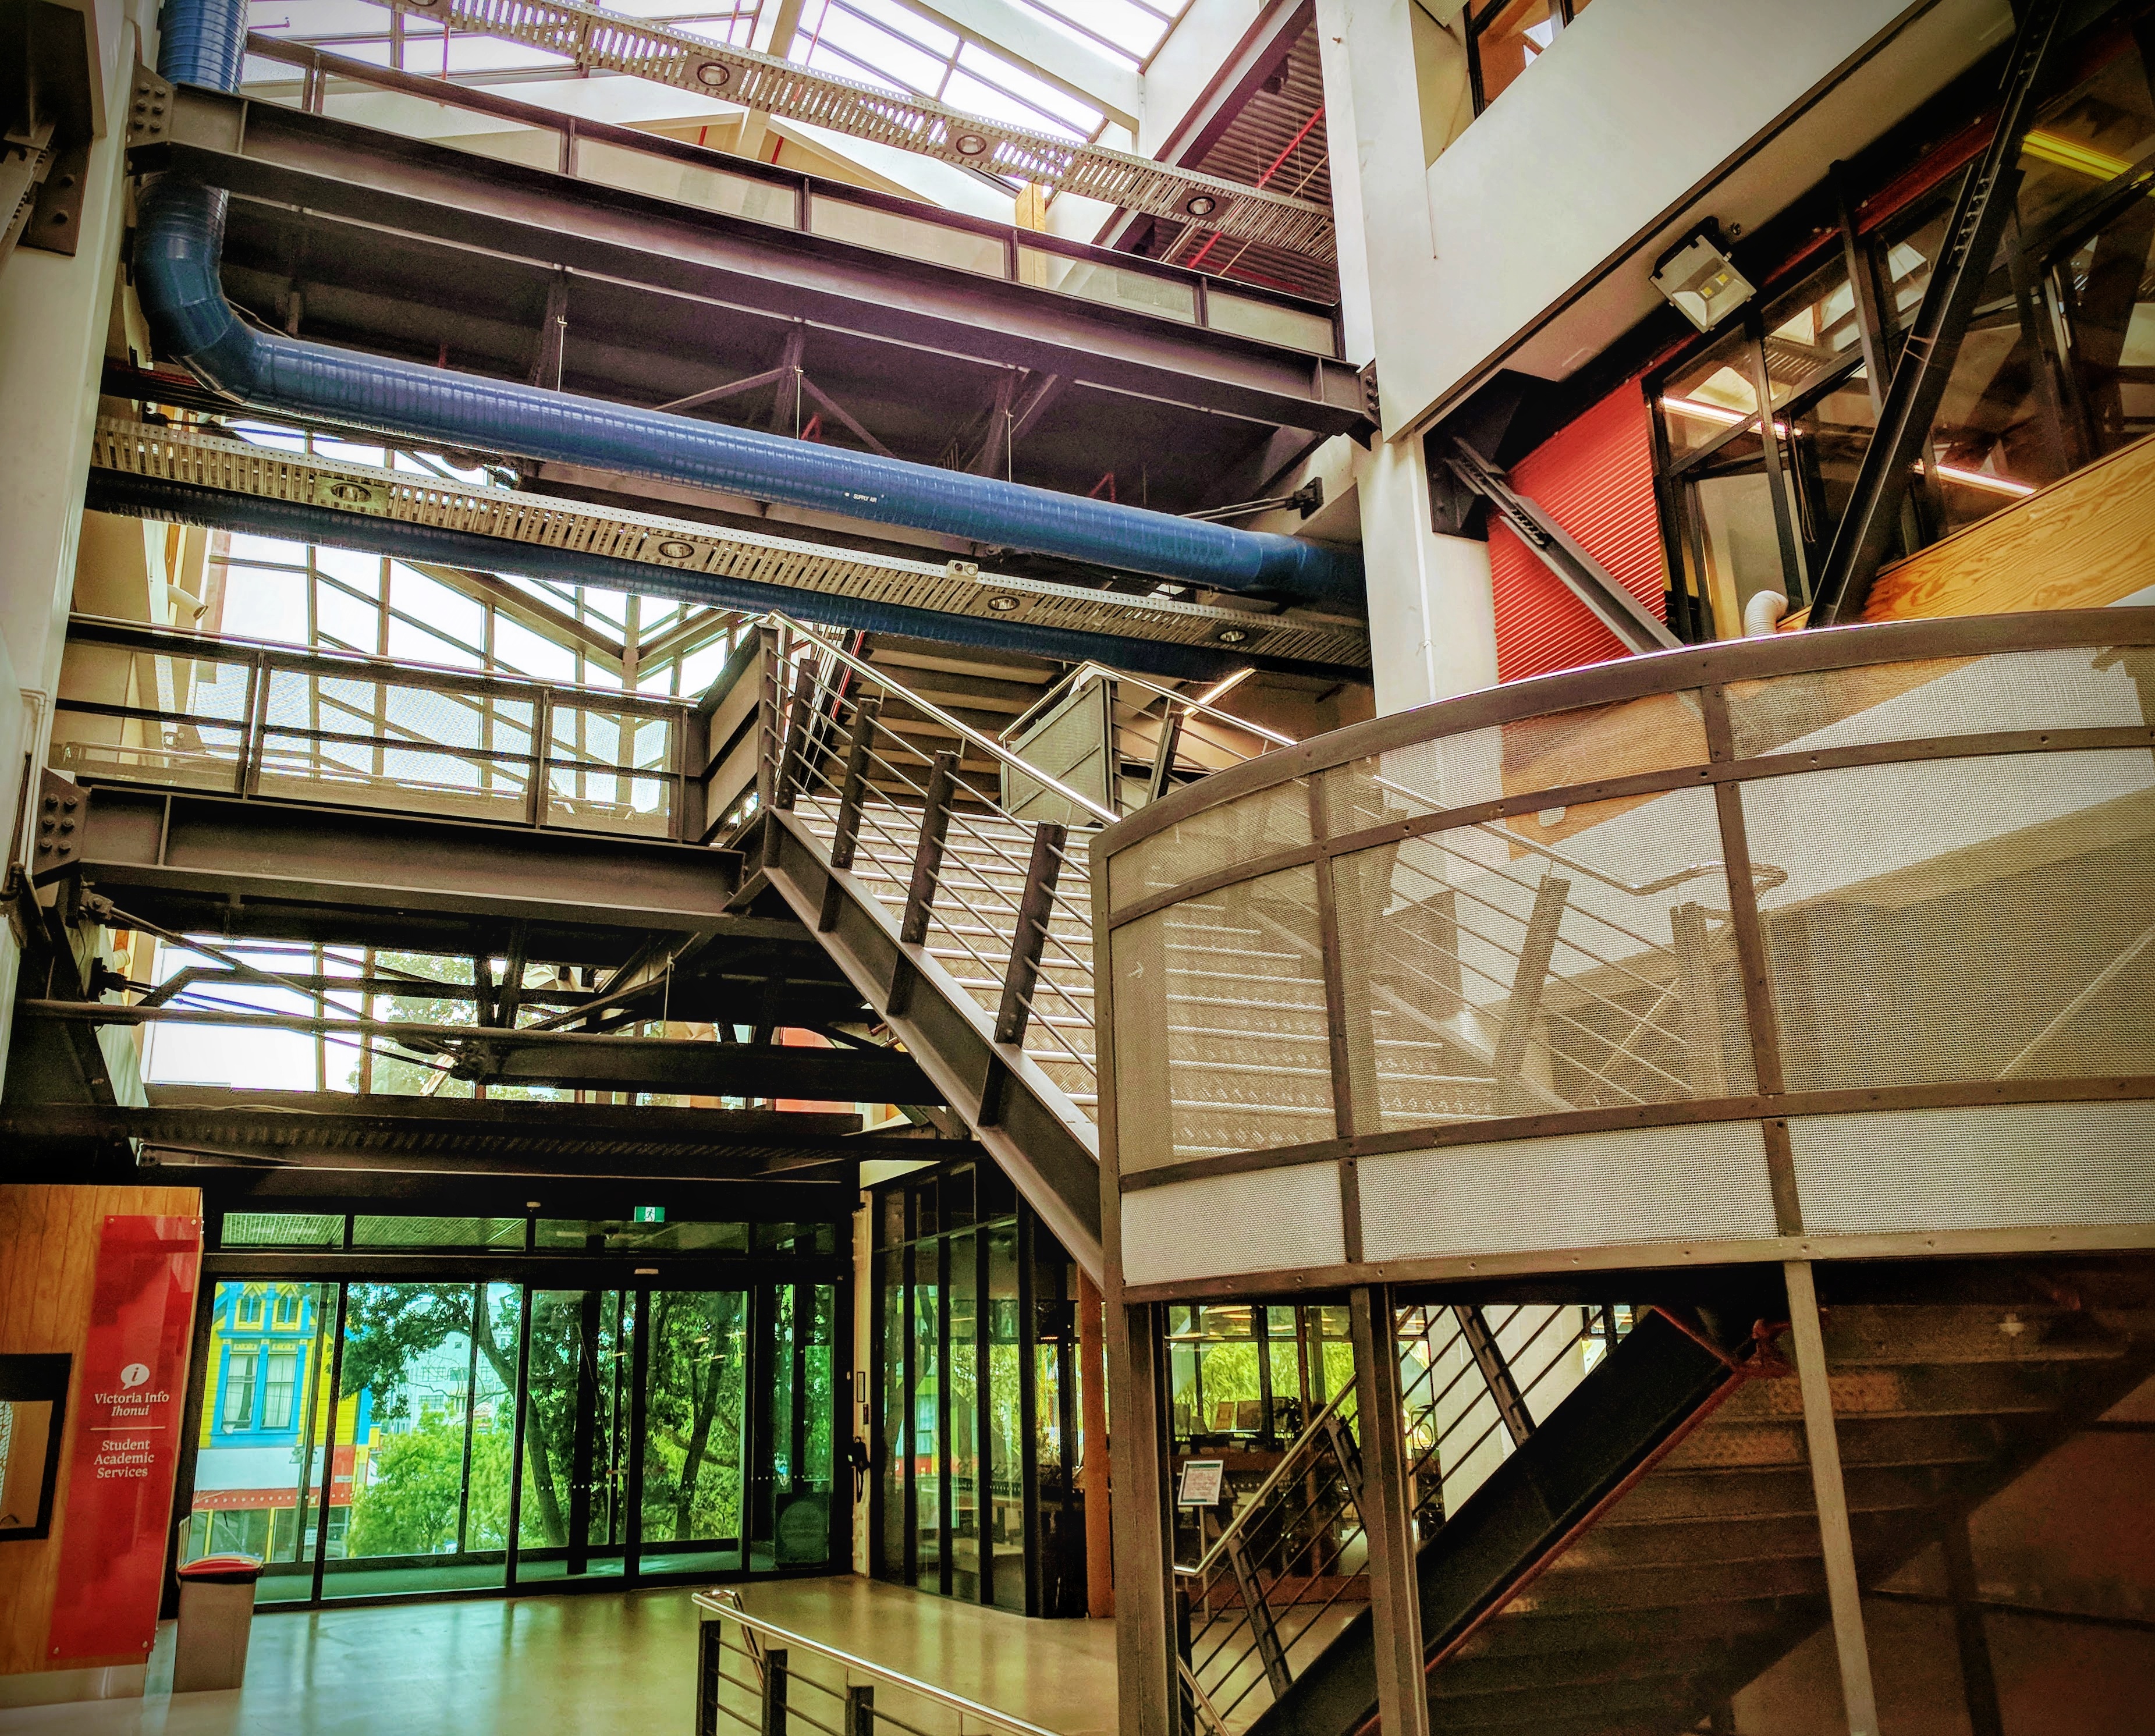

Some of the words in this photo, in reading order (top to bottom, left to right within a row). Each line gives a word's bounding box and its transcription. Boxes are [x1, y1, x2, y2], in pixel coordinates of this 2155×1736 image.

[94, 1392, 142, 1404] Victoria
[145, 1391, 169, 1403] Info
[111, 1405, 150, 1417] Ihonui
[102, 1439, 151, 1451] Student
[94, 1453, 155, 1465] Academic
[97, 1467, 148, 1479] Services
